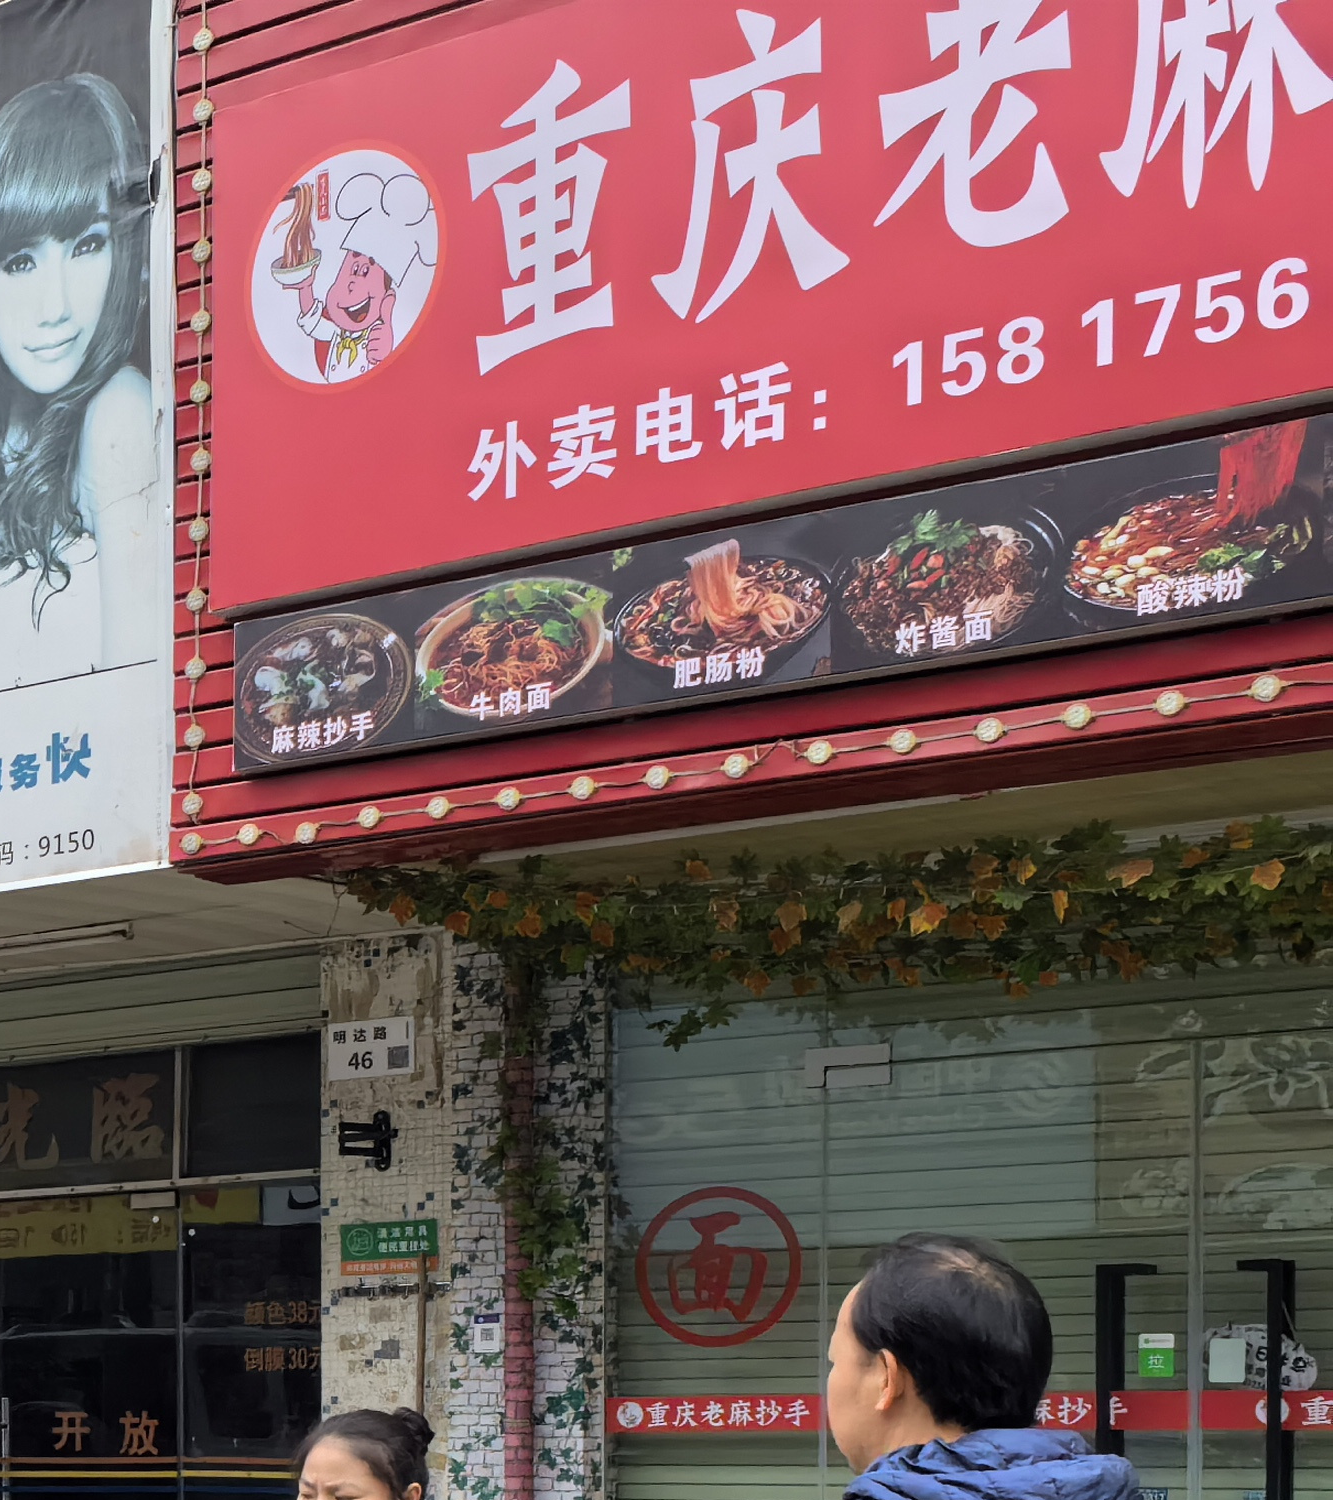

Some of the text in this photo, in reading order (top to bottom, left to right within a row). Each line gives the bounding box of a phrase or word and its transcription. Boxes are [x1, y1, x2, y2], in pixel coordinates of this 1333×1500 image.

[891, 315, 1045, 406] 158
[1079, 255, 1310, 367] 1756
[1135, 567, 1245, 617] 酸辣粉
[894, 609, 994, 656] 炸酱面
[673, 645, 766, 691] 肥肠粉
[468, 681, 553, 722] 牛肉面
[270, 710, 375, 755] 麻辣抄手
[333, 1025, 388, 1045] 明达路
[347, 1050, 375, 1071] 46
[667, 1211, 769, 1322] 面
[52, 1408, 161, 1457] 开放
[645, 1396, 811, 1428] 重庆老麻抄手
